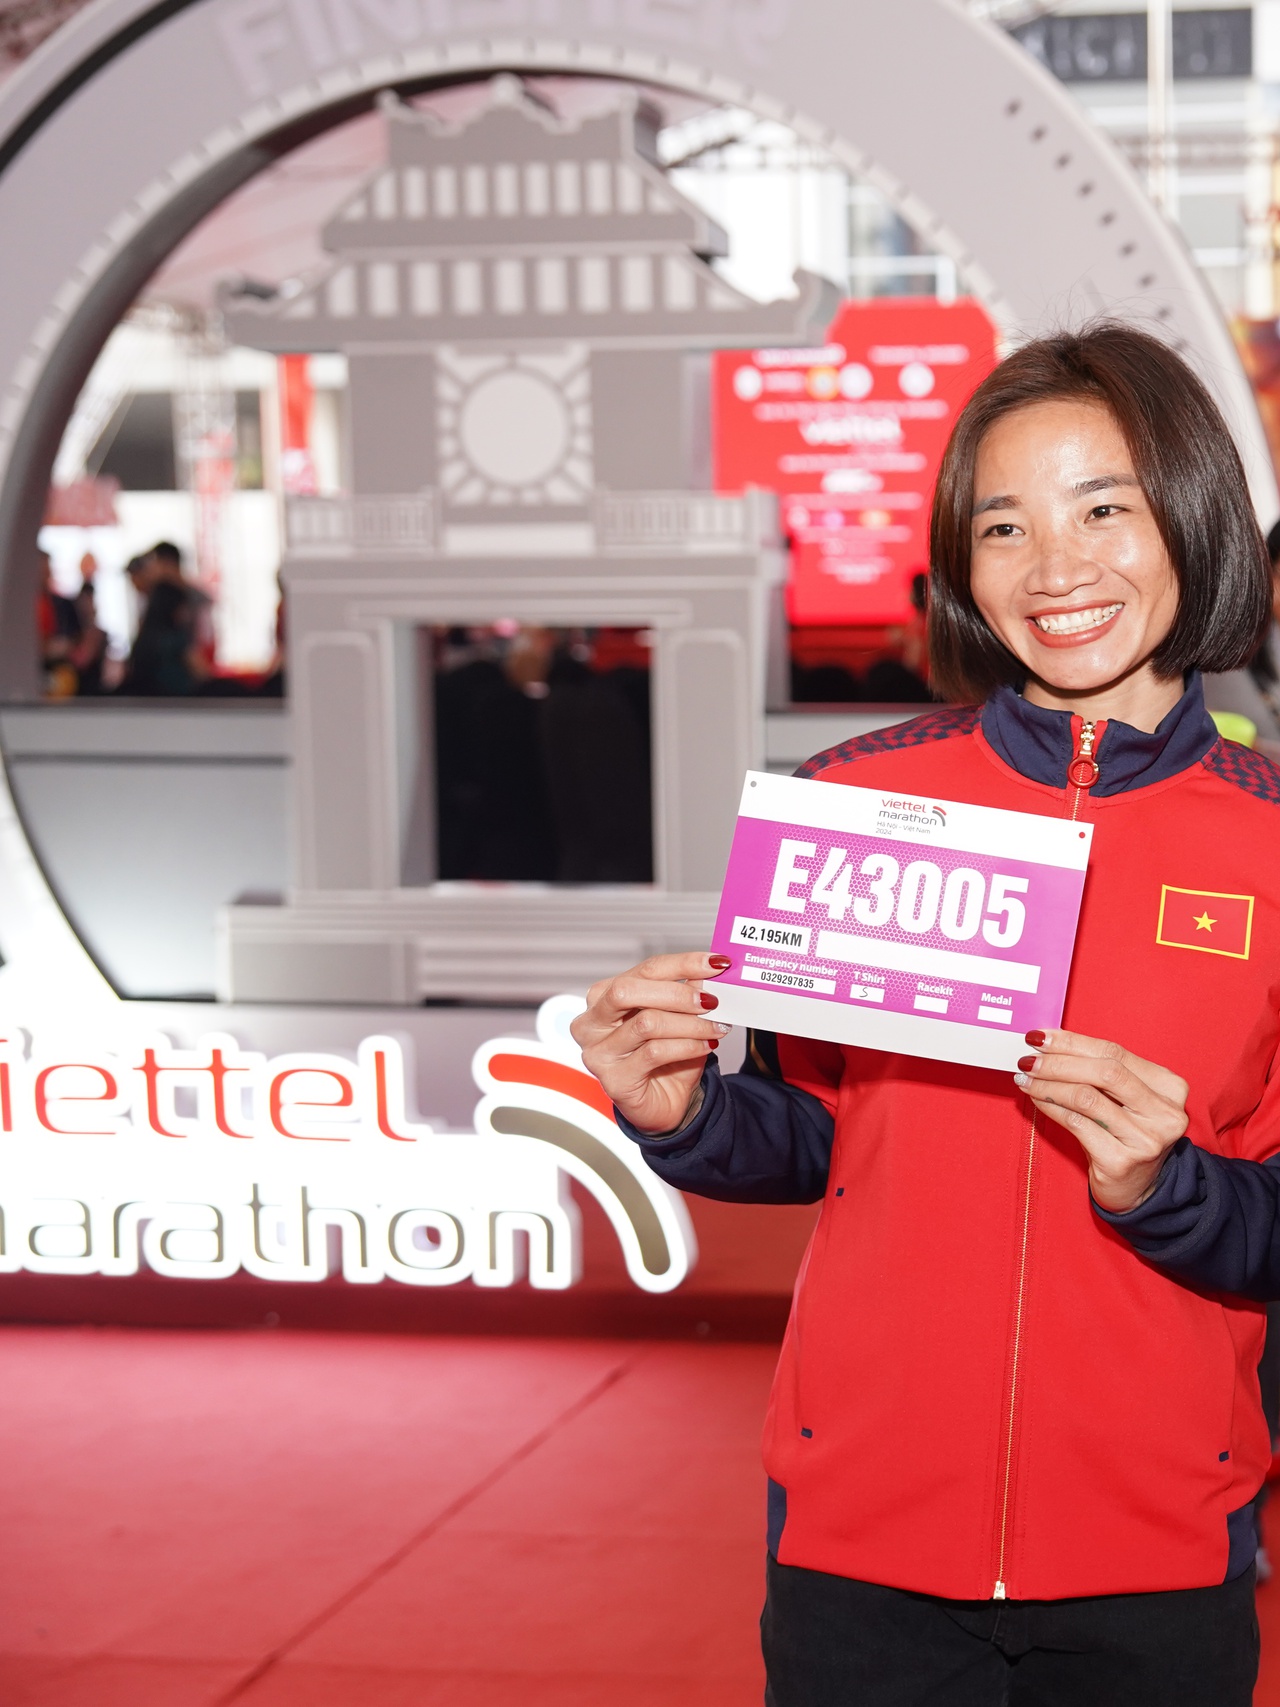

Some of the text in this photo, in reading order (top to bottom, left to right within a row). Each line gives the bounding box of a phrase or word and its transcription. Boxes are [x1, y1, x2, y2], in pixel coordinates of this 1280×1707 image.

[881, 799, 927, 814] viettel
[878, 810, 938, 826] marathon
[875, 827, 893, 836] 2024
[767, 838, 1030, 949] E43005
[740, 925, 803, 948] 42,195KM
[744, 952, 839, 977] Emergency number
[760, 971, 815, 989] 0329297835
[853, 970, 886, 985] T Shirt
[917, 982, 954, 997] Racekit
[981, 992, 1013, 1006] Medal
[0, 1038, 417, 1142] iettel
[0, 1182, 555, 1273] arathon
